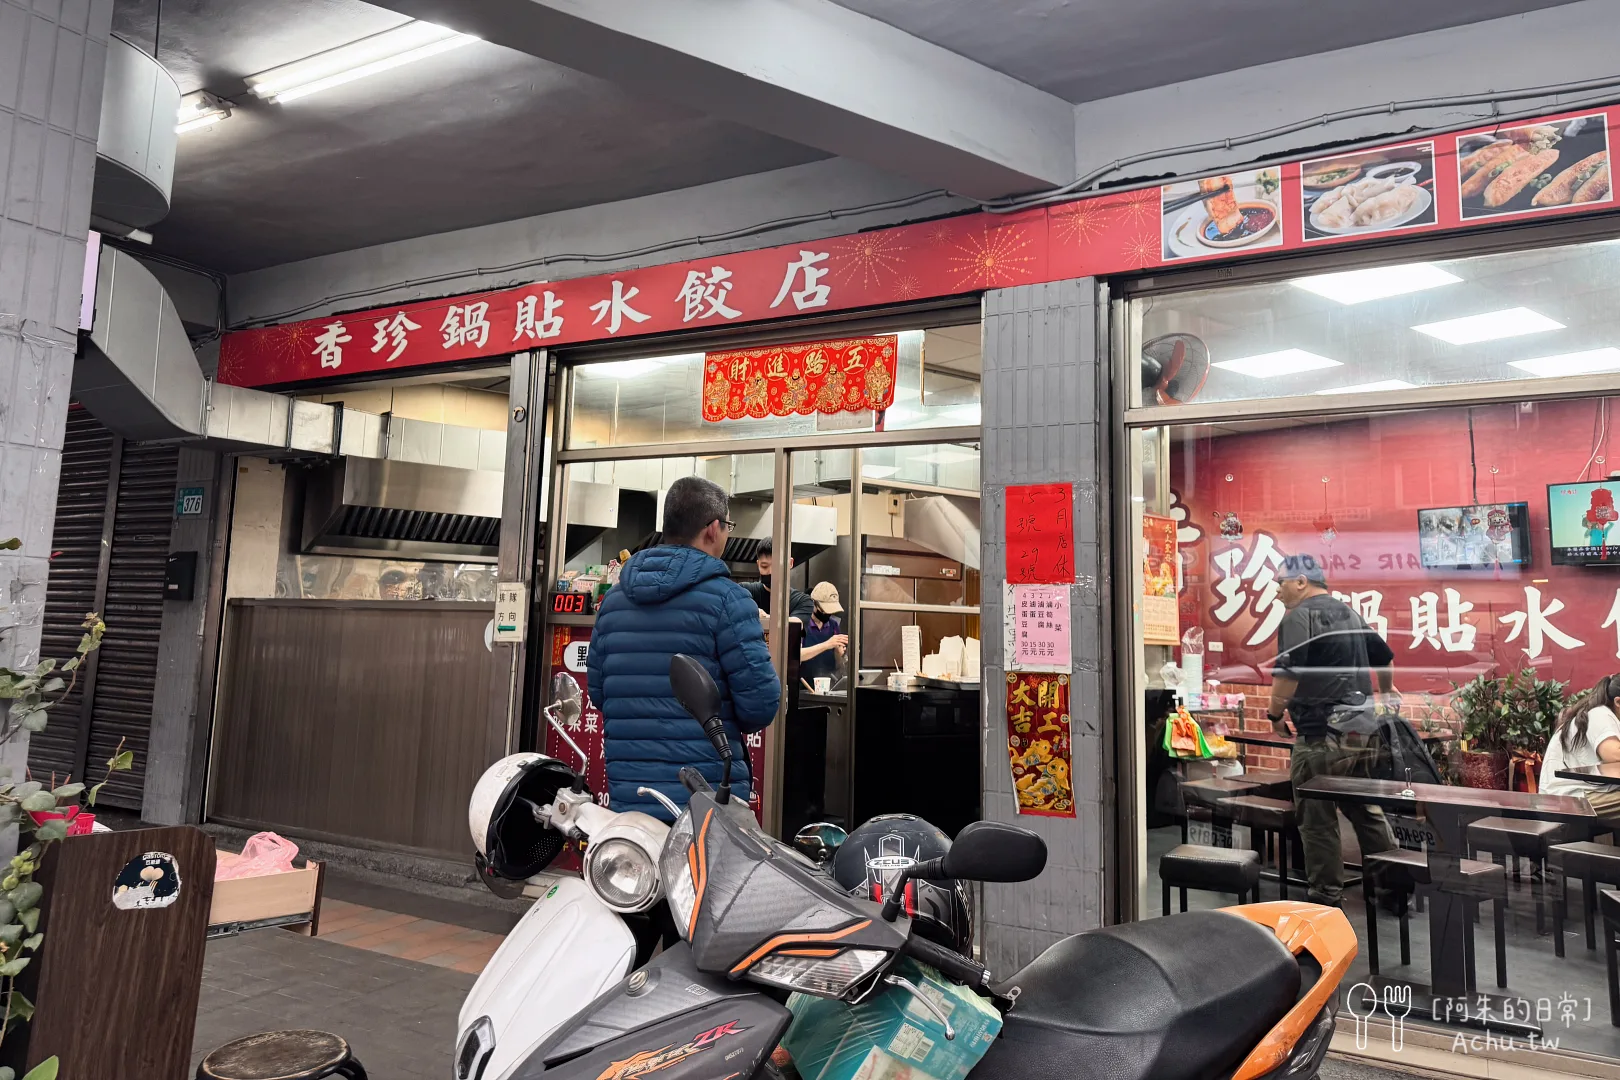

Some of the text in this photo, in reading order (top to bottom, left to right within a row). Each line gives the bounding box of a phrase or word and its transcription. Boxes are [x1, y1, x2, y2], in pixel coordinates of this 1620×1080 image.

[311, 250, 830, 369] 香珍鍋貼水餃店
[184, 497, 201, 512] 376
[498, 611, 516, 622] 方向
[554, 595, 585, 612] 003
[1011, 680, 1036, 734] 大吉
[1037, 681, 1062, 734] 開工
